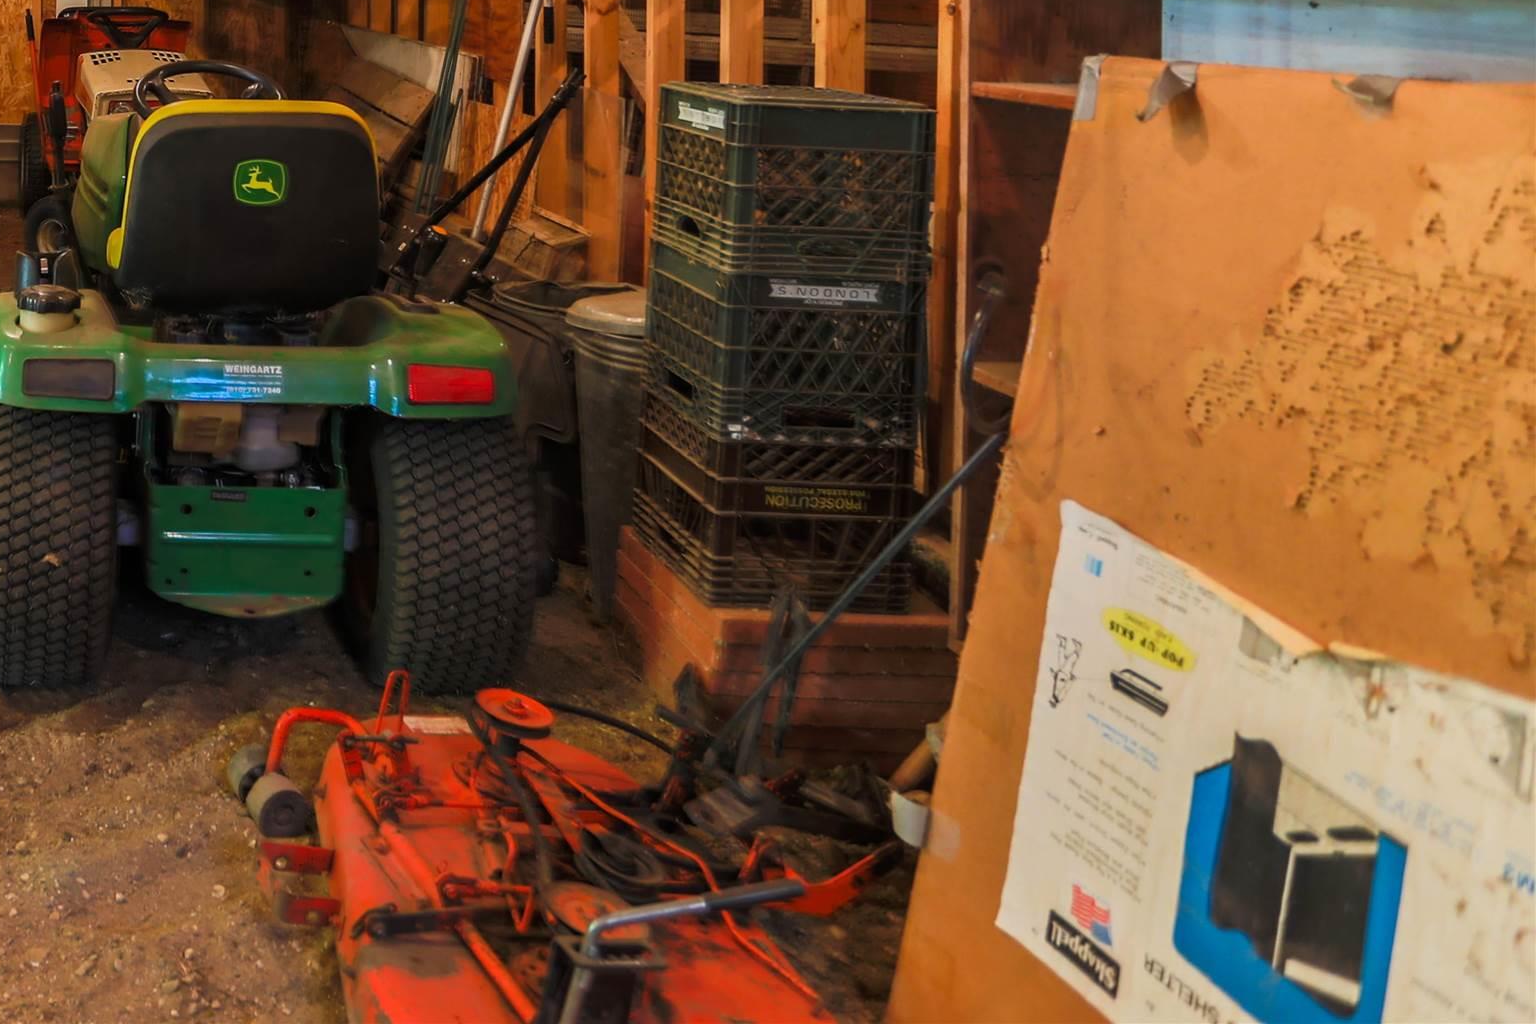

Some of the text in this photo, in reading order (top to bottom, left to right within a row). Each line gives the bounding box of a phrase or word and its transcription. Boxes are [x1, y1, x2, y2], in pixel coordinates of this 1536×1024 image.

[777, 286, 871, 299] LONDON'S
[224, 364, 282, 374] WEINGARTZ
[765, 494, 863, 510] PROSECUTION
[1144, 953, 1220, 1024] SHELTER
